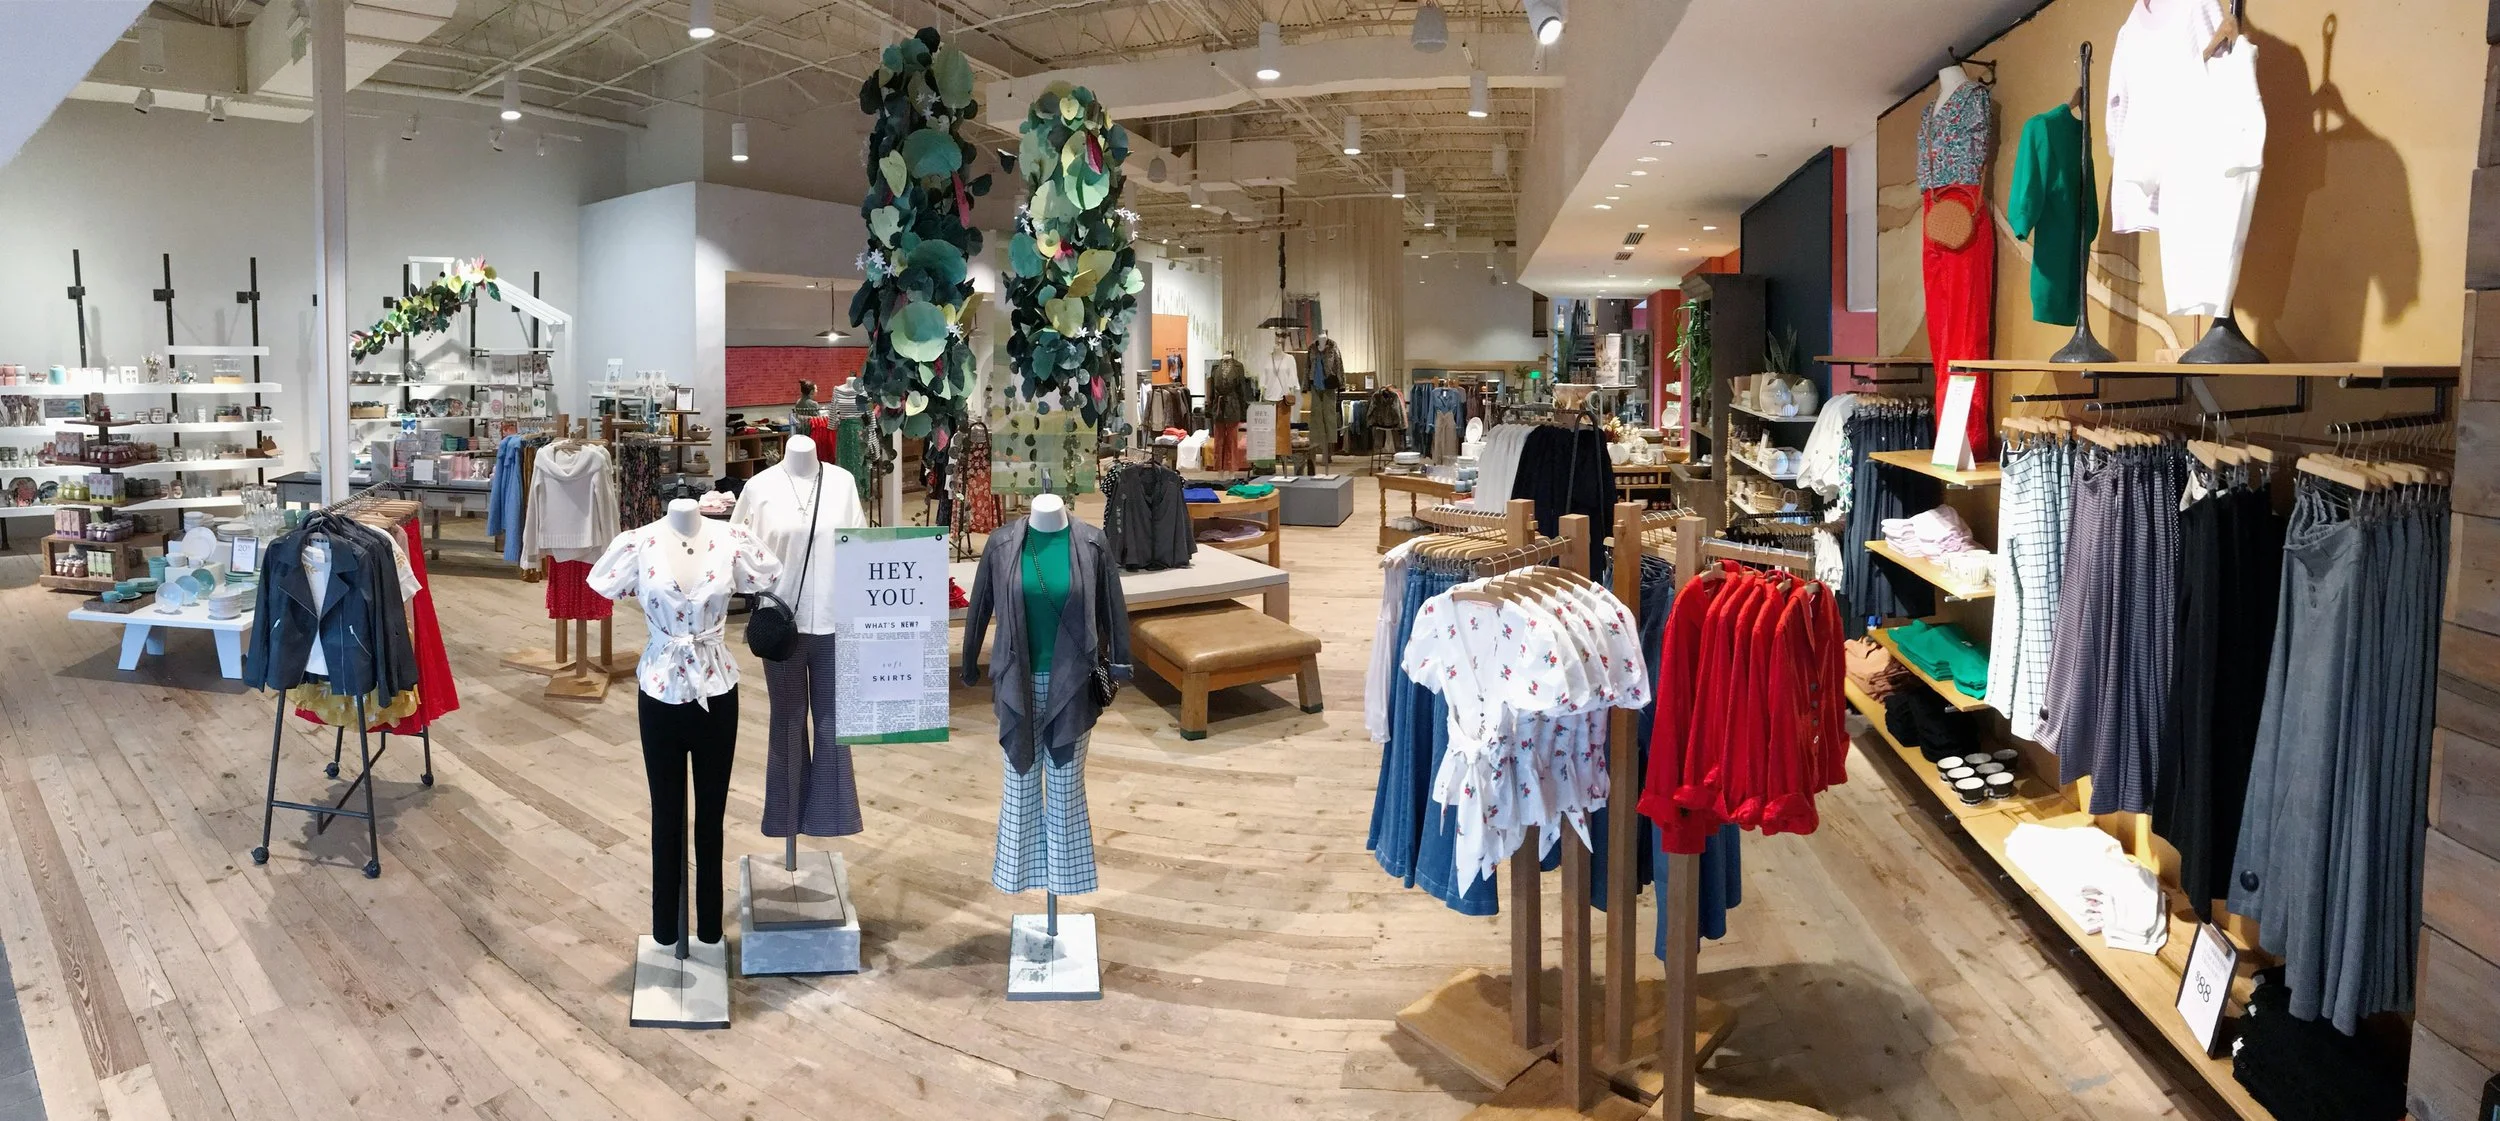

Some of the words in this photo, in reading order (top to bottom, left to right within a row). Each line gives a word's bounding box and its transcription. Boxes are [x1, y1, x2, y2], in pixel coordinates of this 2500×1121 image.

[868, 561, 923, 582] HEY,
[865, 588, 924, 607] YOU.
[864, 621, 896, 630] WHAT'S
[900, 620, 919, 629] NEW?
[872, 674, 912, 682] SKIRTS
